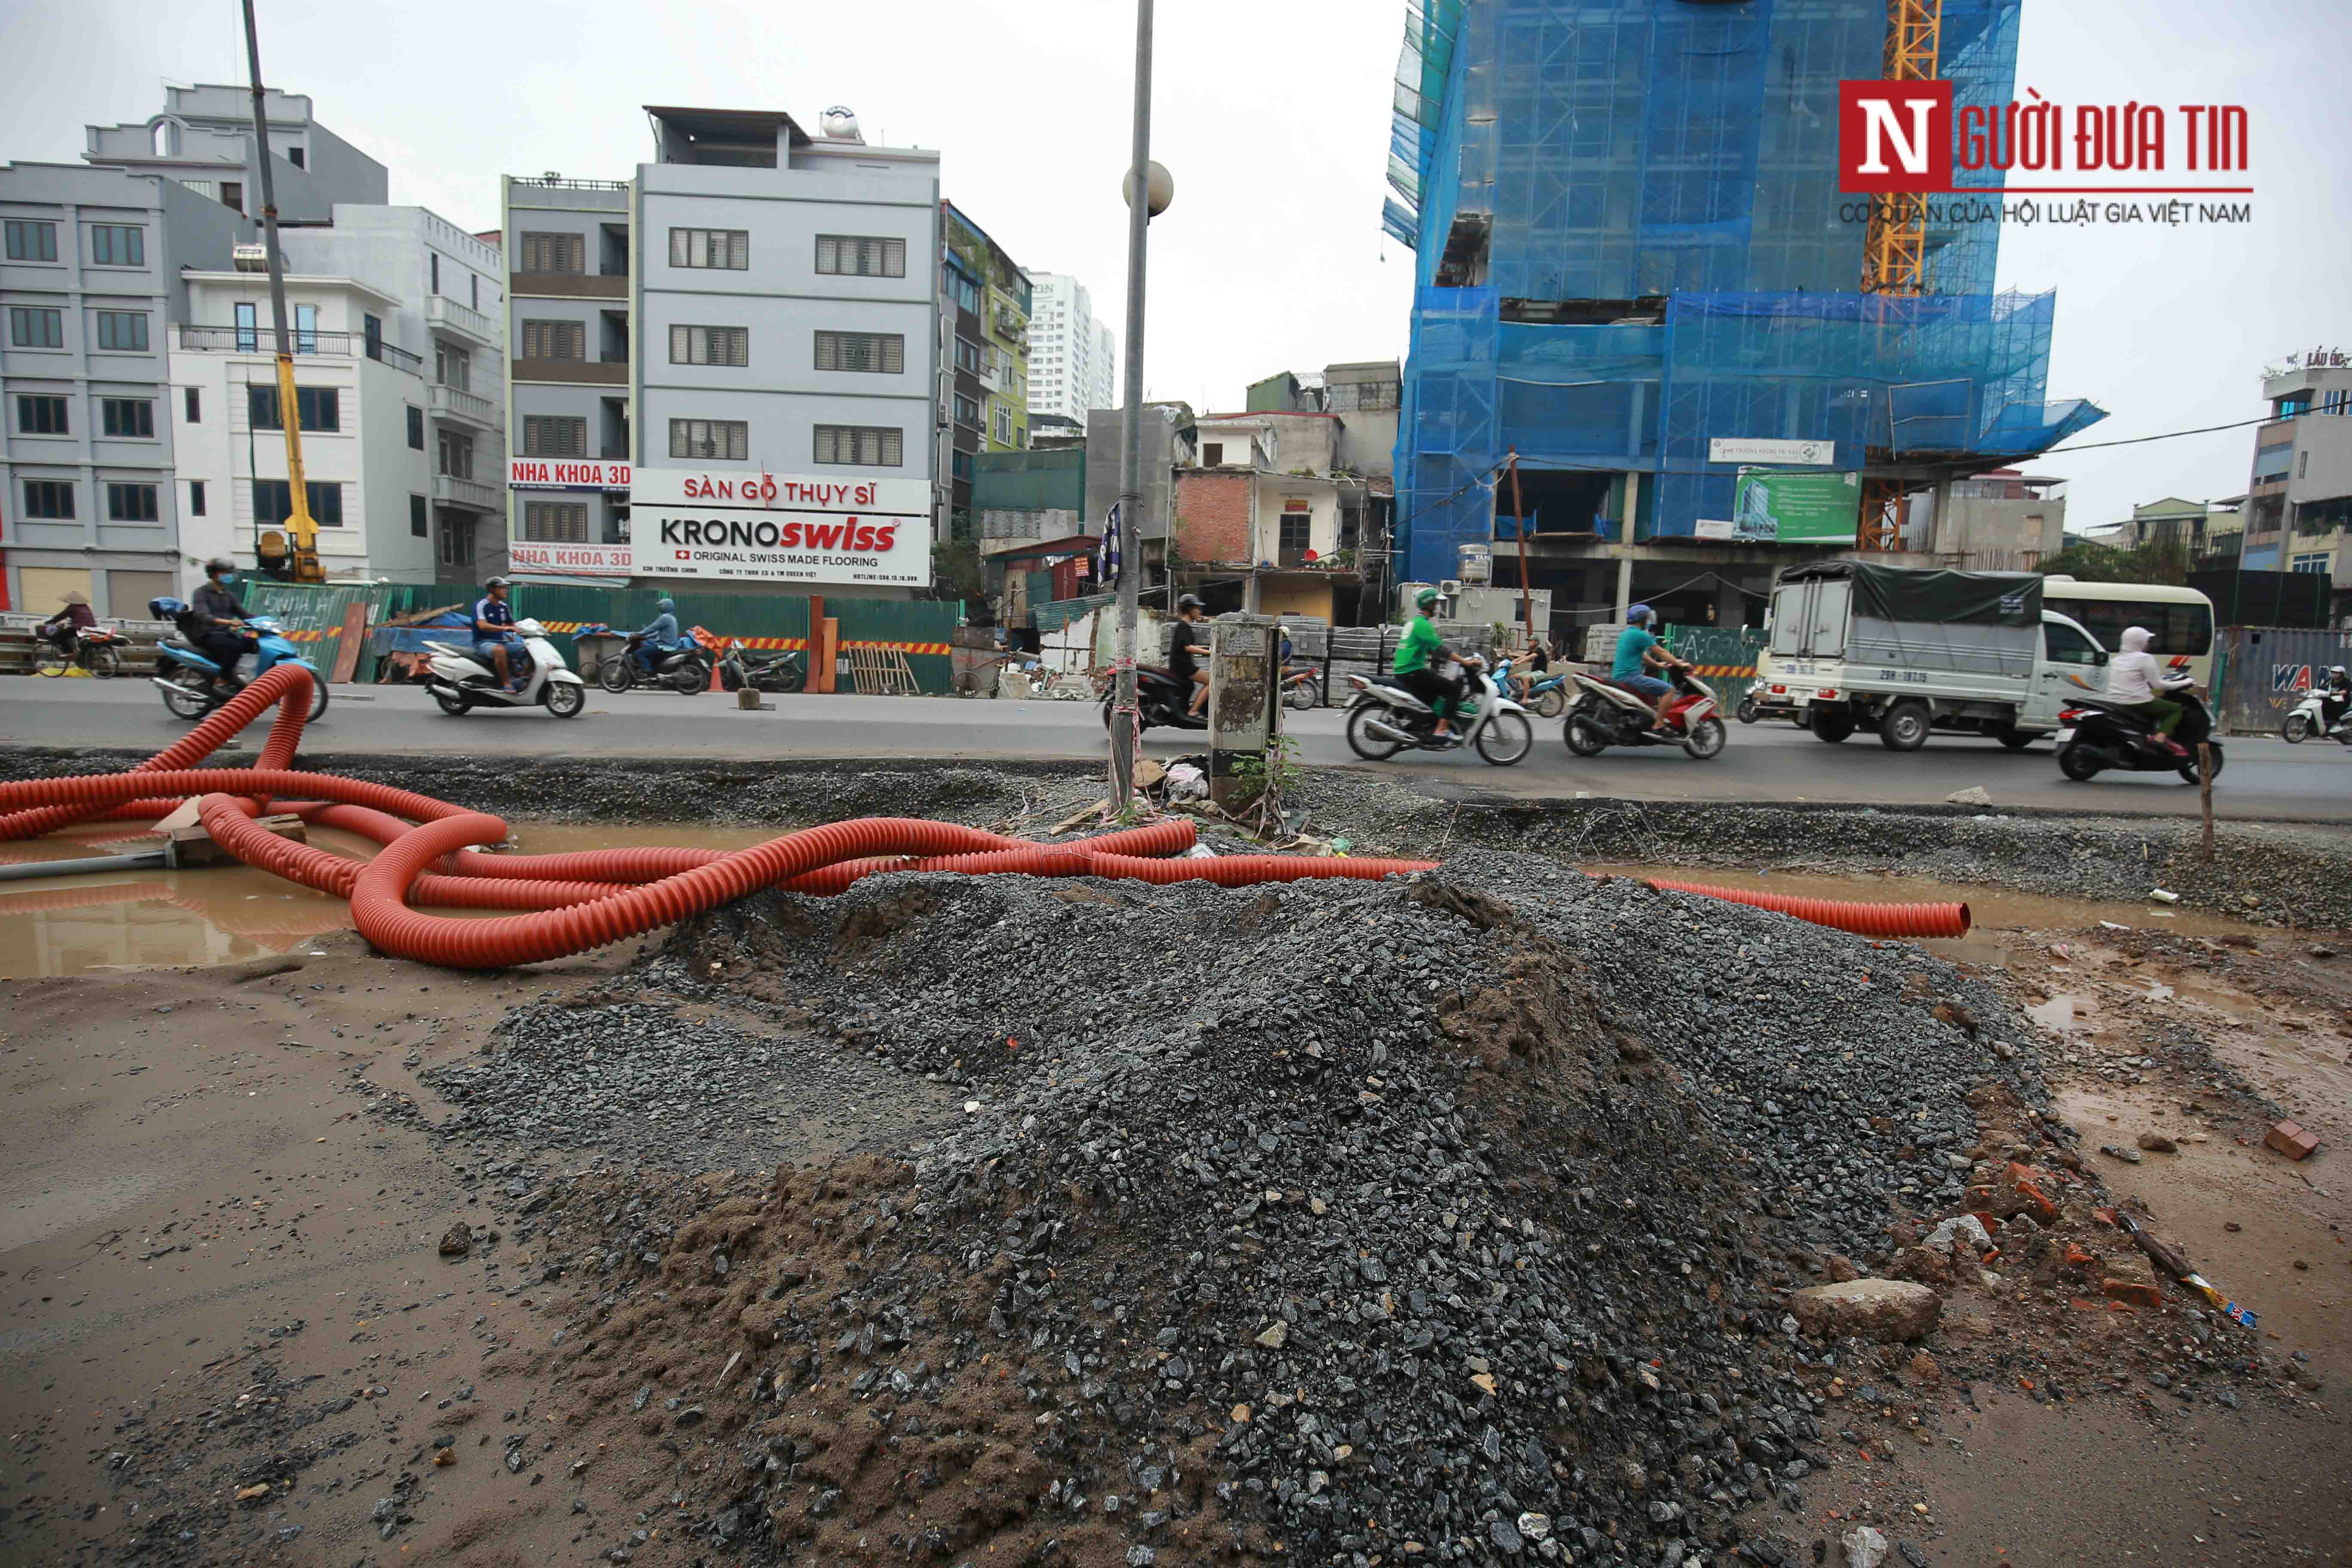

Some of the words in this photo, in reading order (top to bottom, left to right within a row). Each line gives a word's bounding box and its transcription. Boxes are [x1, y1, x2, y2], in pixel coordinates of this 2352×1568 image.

[512, 462, 548, 481] NHA
[555, 464, 602, 483] KHOA
[608, 466, 631, 484] 3D
[684, 474, 732, 499] SÀN
[741, 473, 777, 500] GỖ
[784, 482, 849, 506] THỤY
[854, 481, 877, 505] SĨ
[512, 550, 550, 564] NHA
[556, 551, 604, 566] KHOA
[609, 553, 632, 567] 3D
[694, 551, 745, 562] ORIGINAL
[749, 552, 785, 563] SWISS
[787, 554, 820, 564] MADE
[823, 556, 878, 567] FLOORING
